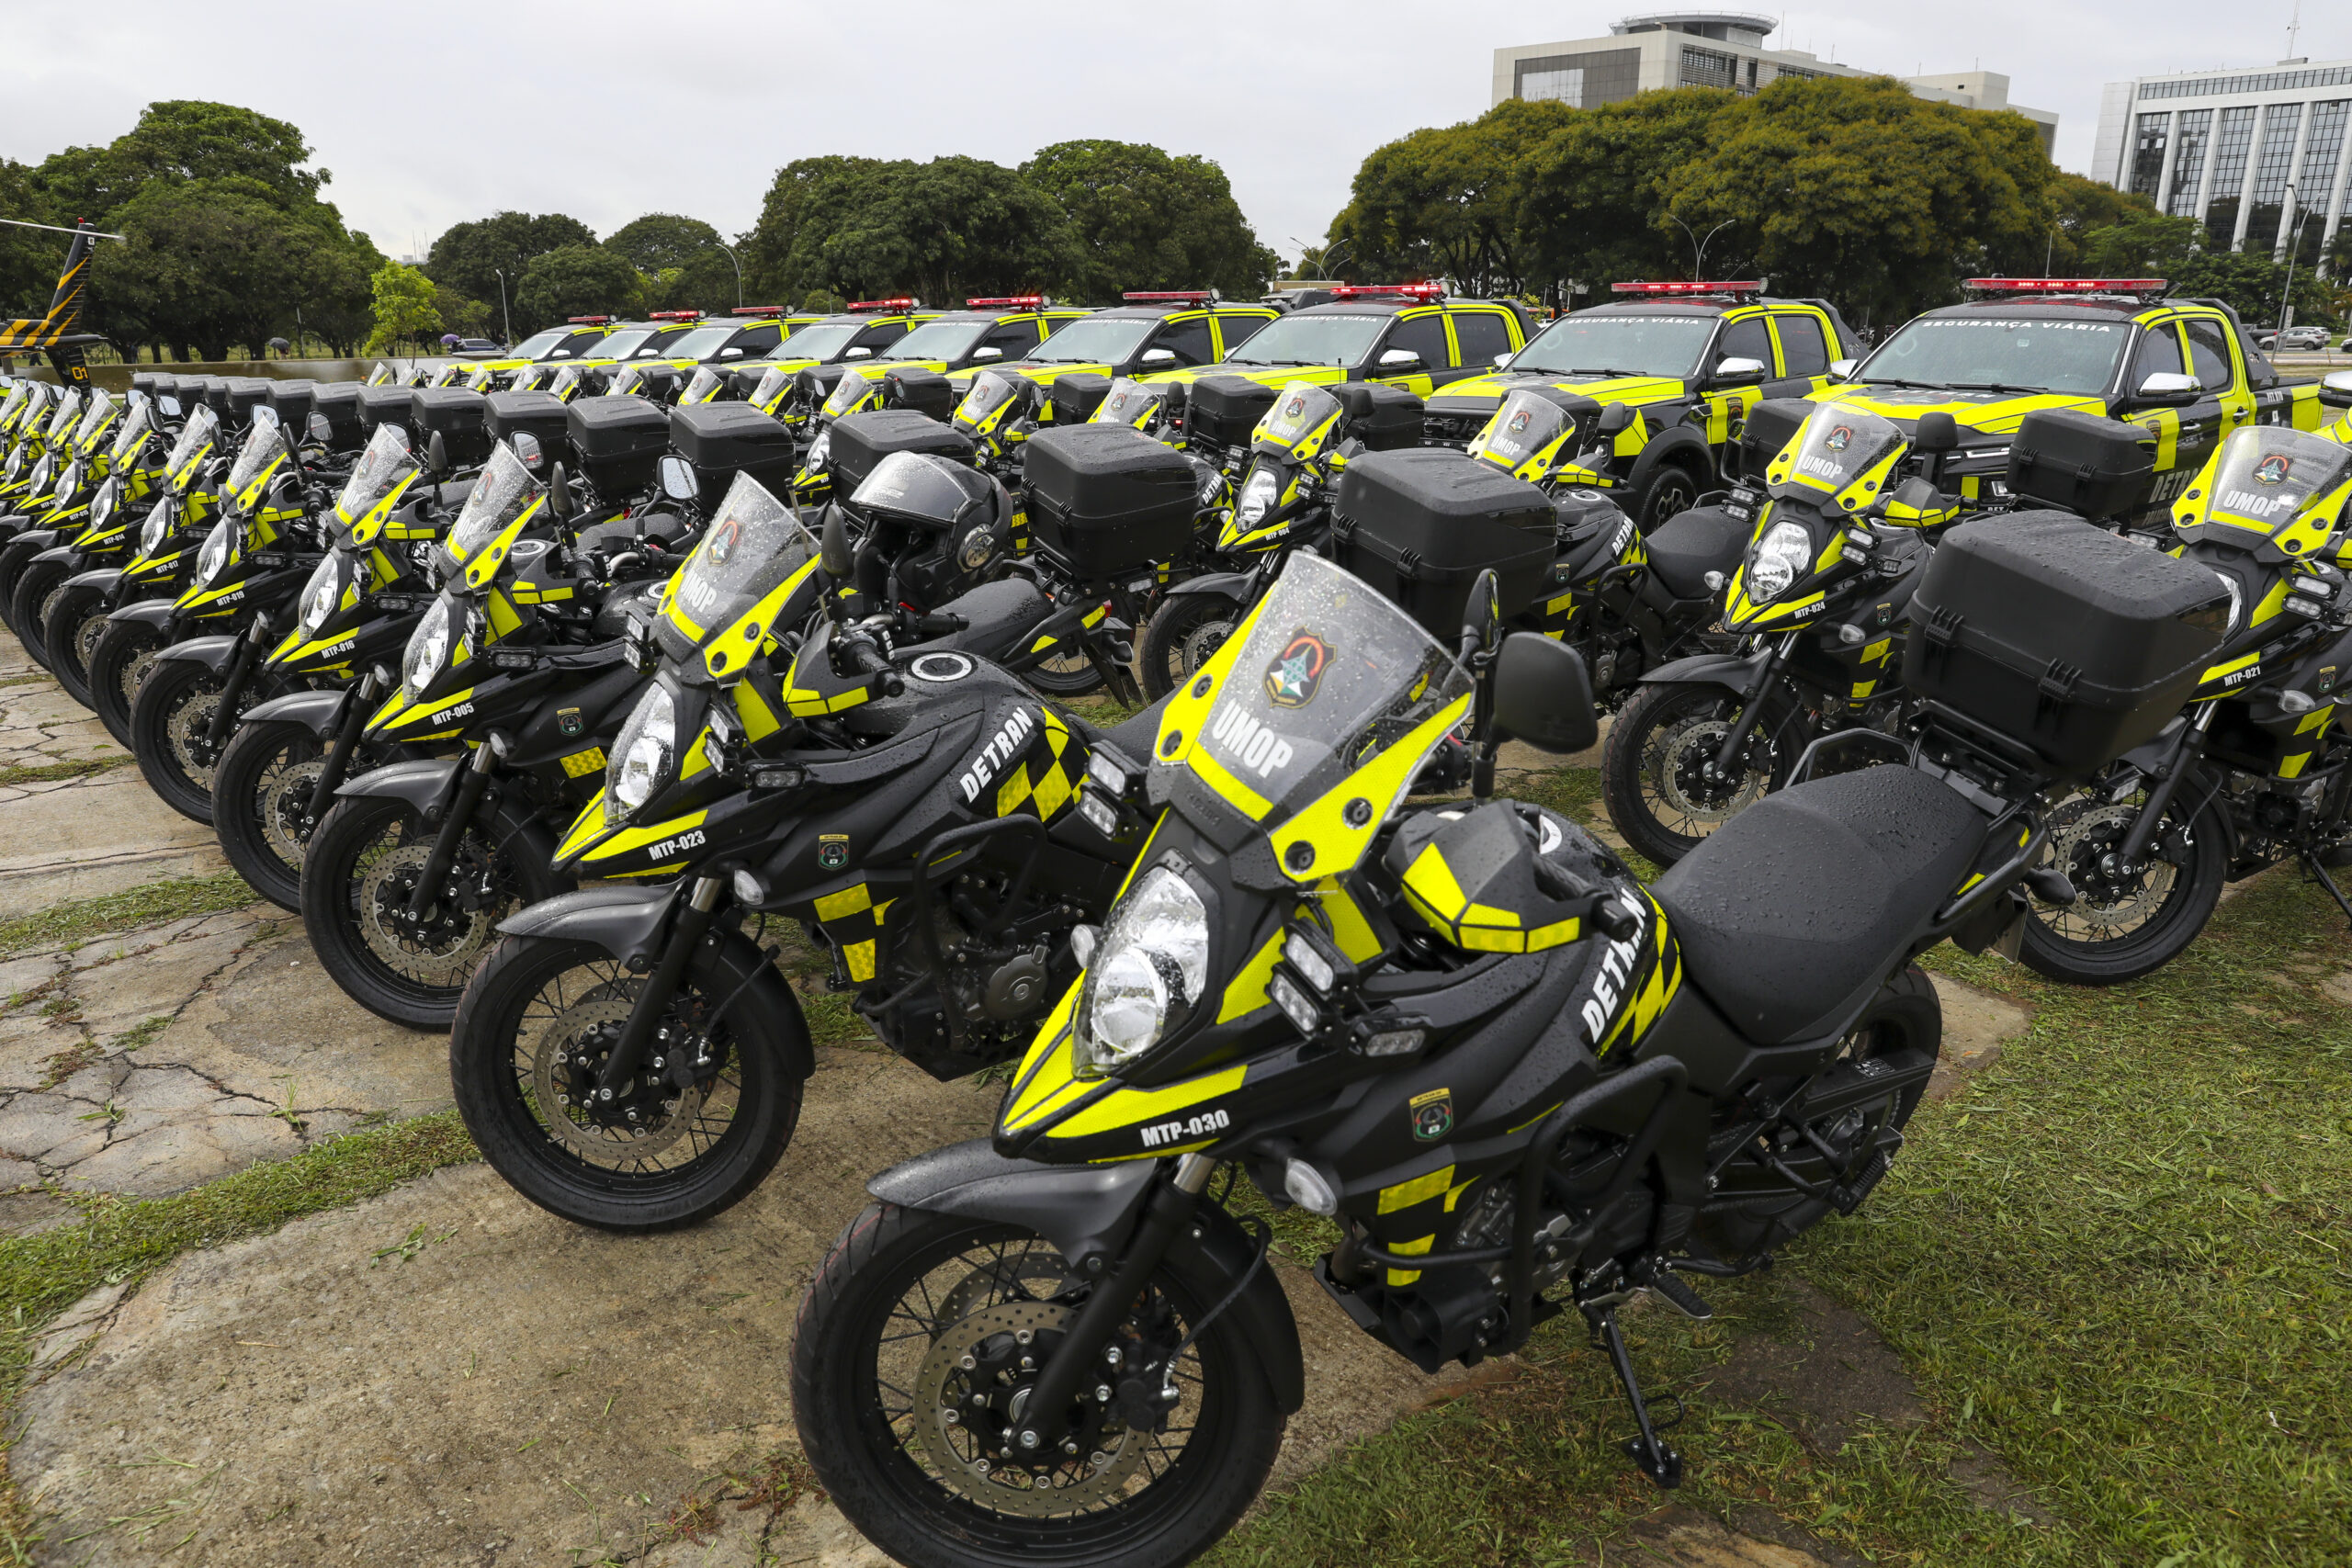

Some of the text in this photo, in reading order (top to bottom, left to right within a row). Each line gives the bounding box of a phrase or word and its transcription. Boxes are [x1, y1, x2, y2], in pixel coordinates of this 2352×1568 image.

[1651, 317, 1699, 325] VIÁRIA
[1922, 321, 2110, 333] SEGURANÇA VIÁRIA
[72, 367, 89, 379] 01
[1271, 420, 1297, 437] UMOP
[1490, 434, 1521, 456] UMOP
[1802, 455, 1843, 479] UMOP
[2222, 490, 2282, 518] UMOP
[103, 534, 126, 546] MTP-014
[155, 560, 179, 574] MTP-017
[216, 590, 245, 607] MTP-019
[680, 569, 718, 613] UMOP
[1794, 601, 1826, 620] MTP-024
[322, 639, 356, 660] MTP-016
[2223, 665, 2261, 687] MTP-021
[431, 702, 475, 726] MTP-005
[1212, 697, 1294, 779] UMOP
[959, 706, 1034, 804] DETRAN
[648, 829, 706, 861] MTP-023
[1140, 1109, 1230, 1147] MTP-030
